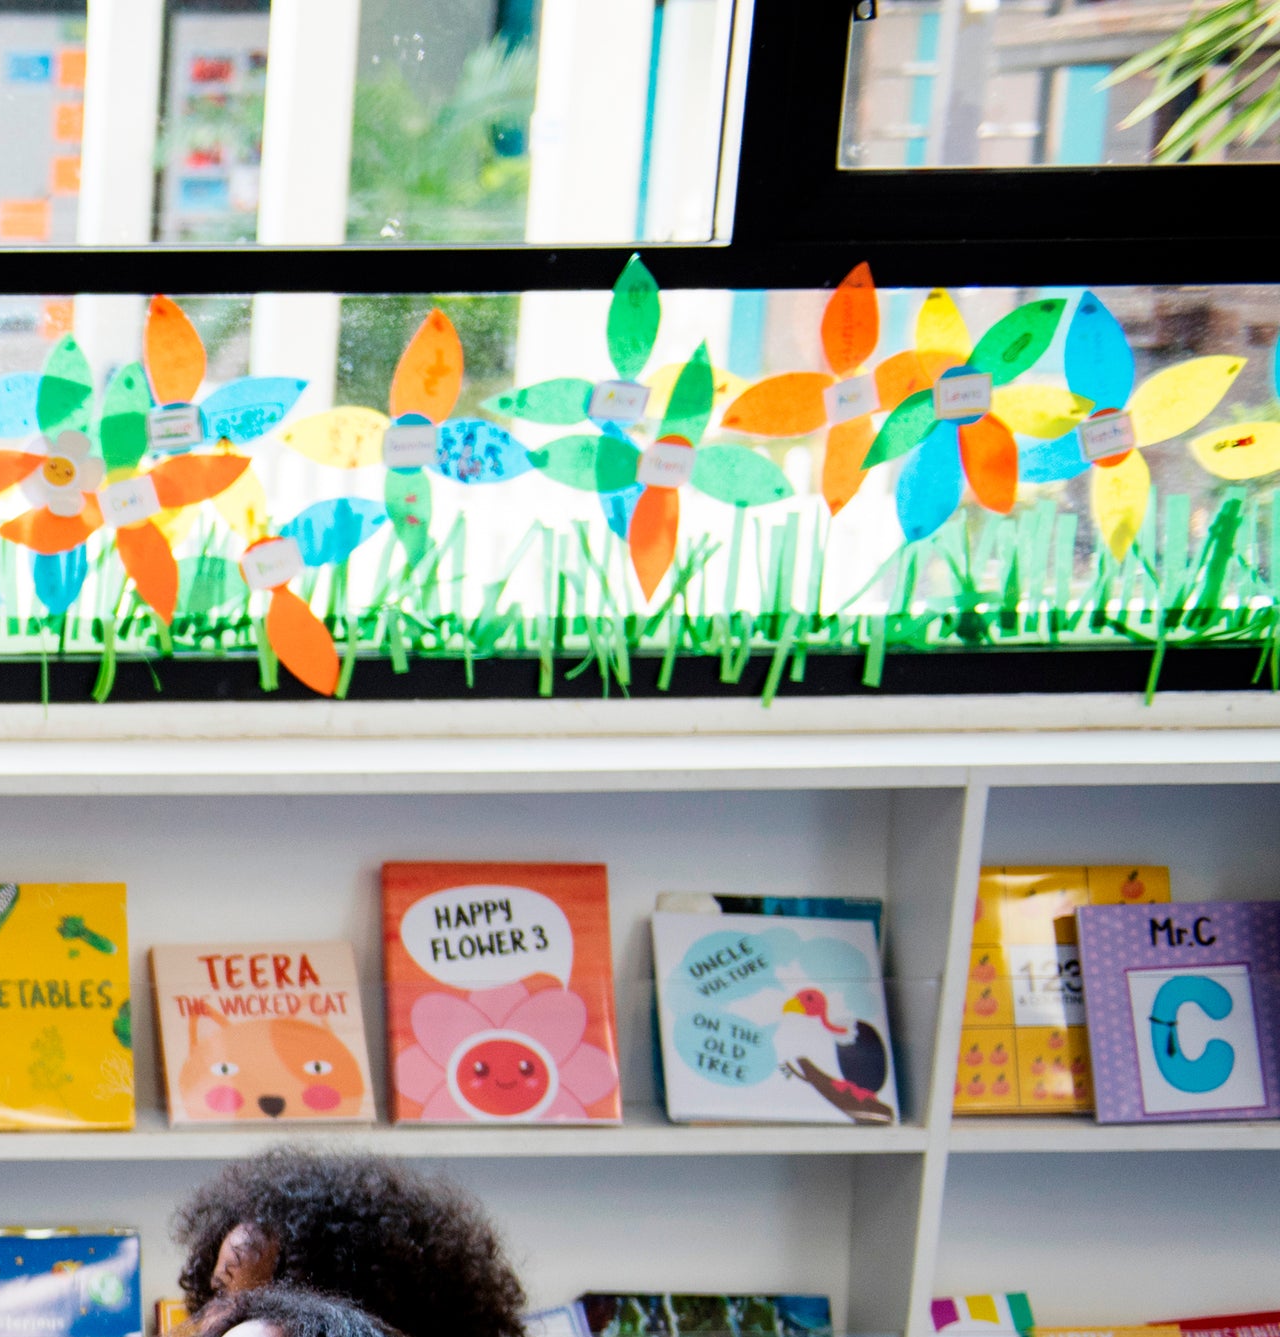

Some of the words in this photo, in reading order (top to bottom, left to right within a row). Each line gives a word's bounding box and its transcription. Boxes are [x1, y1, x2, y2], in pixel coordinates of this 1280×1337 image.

[435, 898, 513, 930] HAPPY
[431, 931, 527, 962] FLOWER
[534, 927, 548, 952] 3
[1149, 917, 1216, 948] Mr.C
[198, 953, 320, 990] TEERA
[689, 938, 753, 978] UNCLE
[698, 953, 768, 996] VULTURE
[174, 994, 210, 1016] THE
[219, 992, 301, 1016] WICKED
[309, 991, 348, 1016] CAT
[693, 1013, 720, 1031] ON
[731, 1023, 762, 1044] THE
[704, 1036, 746, 1059] OLD
[695, 1050, 747, 1080] TREE
